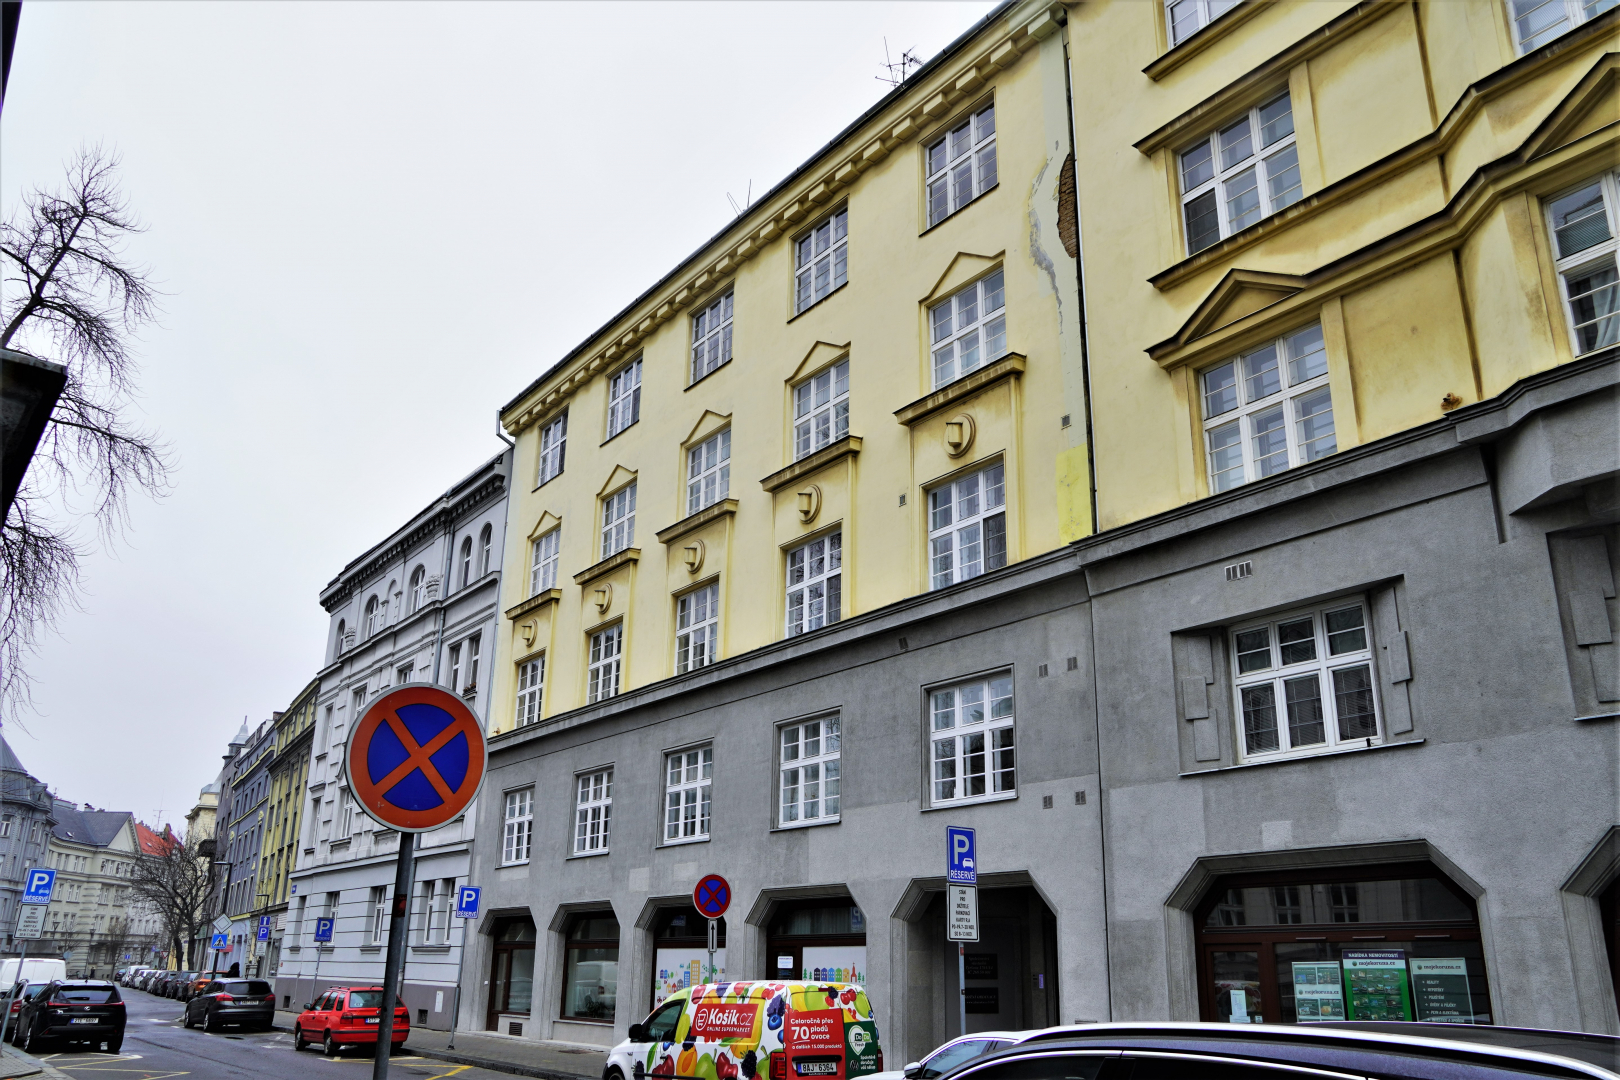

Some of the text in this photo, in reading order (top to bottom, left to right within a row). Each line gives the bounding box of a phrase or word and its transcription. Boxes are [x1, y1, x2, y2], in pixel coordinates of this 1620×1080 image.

[953, 834, 970, 865] P
[30, 872, 50, 892] P
[950, 869, 975, 880] RÉSERVÉ
[461, 890, 476, 908] P
[260, 928, 268, 936] P
[318, 920, 331, 935] P
[791, 1026, 810, 1040] 70
